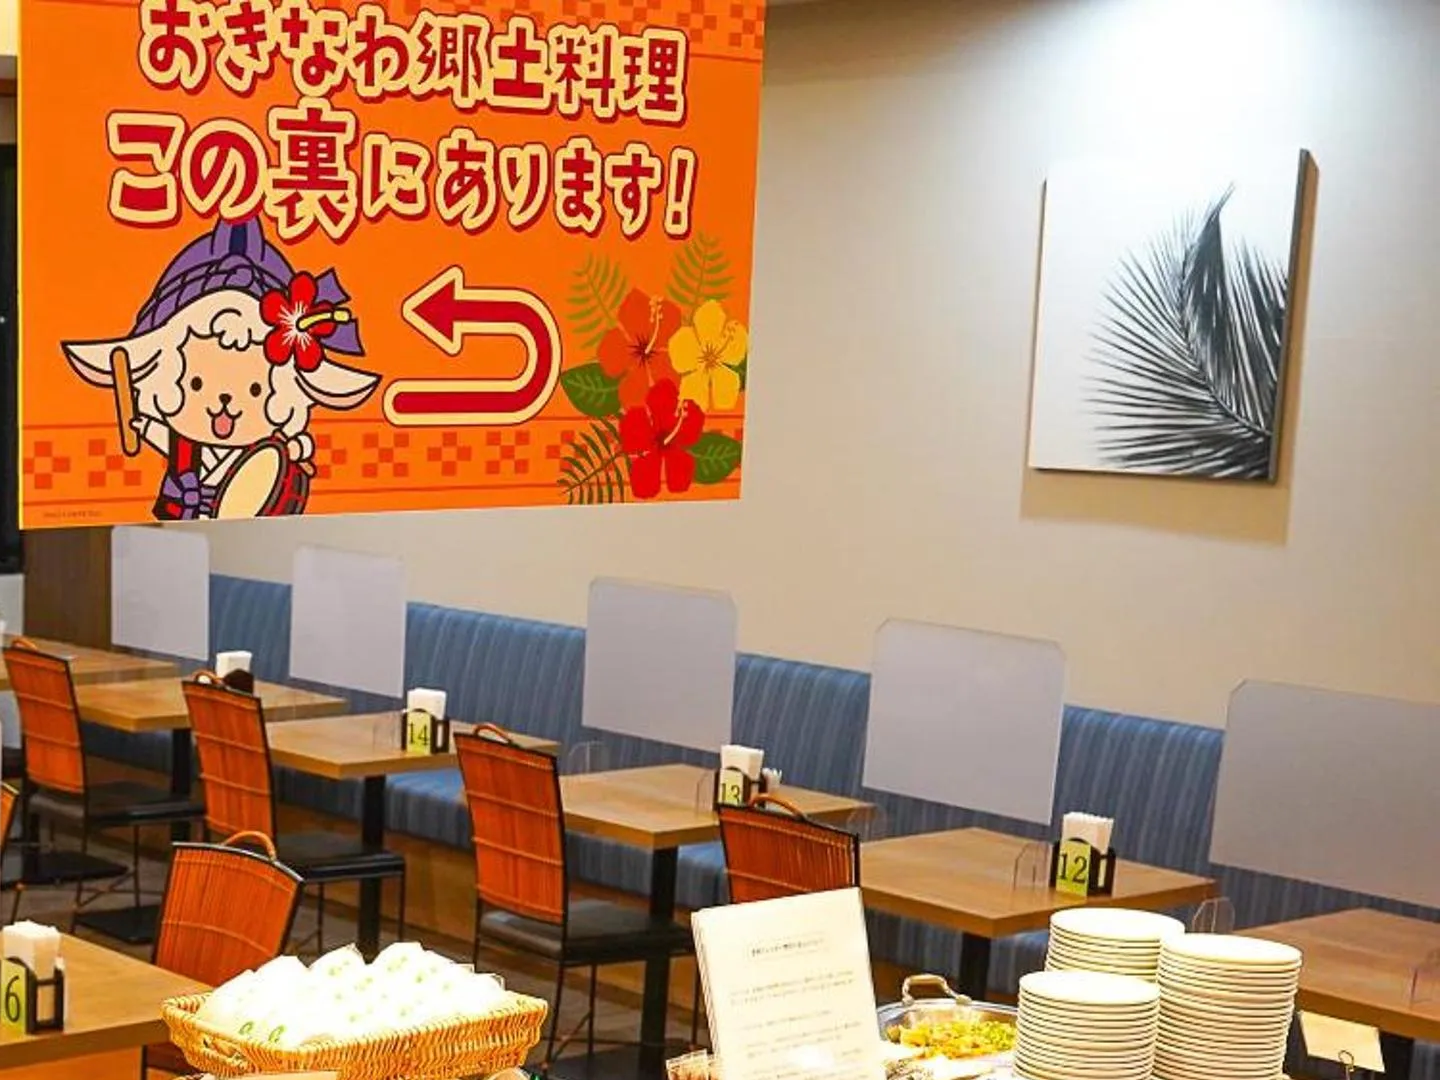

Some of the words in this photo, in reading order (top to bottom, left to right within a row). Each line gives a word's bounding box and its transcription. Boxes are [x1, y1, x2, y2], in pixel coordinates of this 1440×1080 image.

[139, 0, 687, 122] おきなわ郷土料理
[107, 94, 698, 241] この裏にあります！
[409, 722, 429, 746] 14
[1057, 853, 1088, 884] 12
[5, 975, 21, 1023] 6
